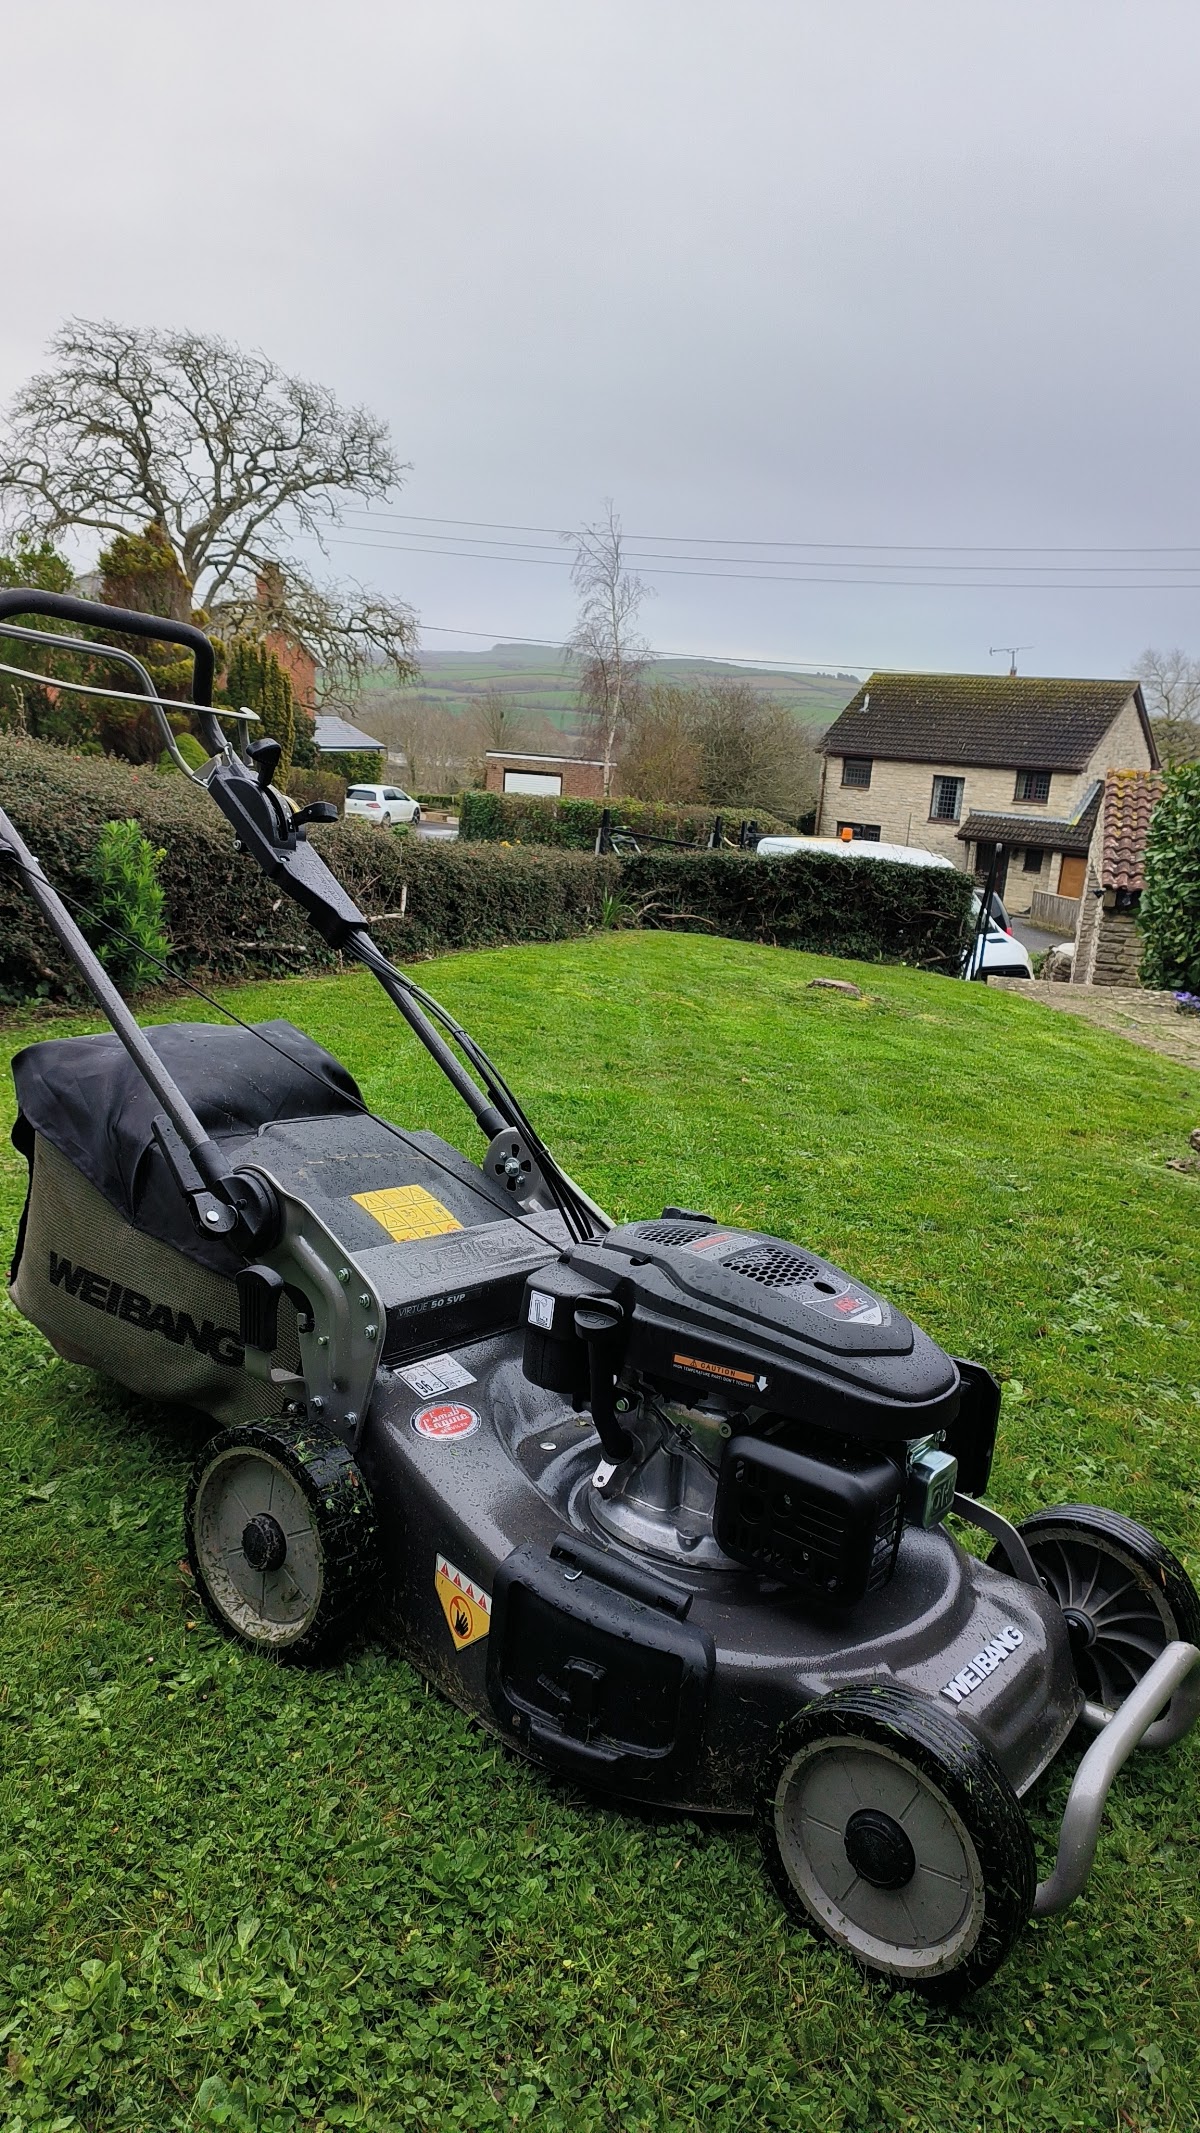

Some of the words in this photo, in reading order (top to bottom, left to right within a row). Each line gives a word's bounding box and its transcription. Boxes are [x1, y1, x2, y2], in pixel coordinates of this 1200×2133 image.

[49, 1250, 246, 1368] WEIBANG
[399, 1302, 428, 1316] VIRTUE
[430, 1299, 444, 1309] 50
[446, 1293, 466, 1305] SVP
[683, 1366, 711, 1377] TEMPERATURE
[700, 1363, 736, 1377] CAUTION
[940, 1625, 1024, 1703] WEIBANG
